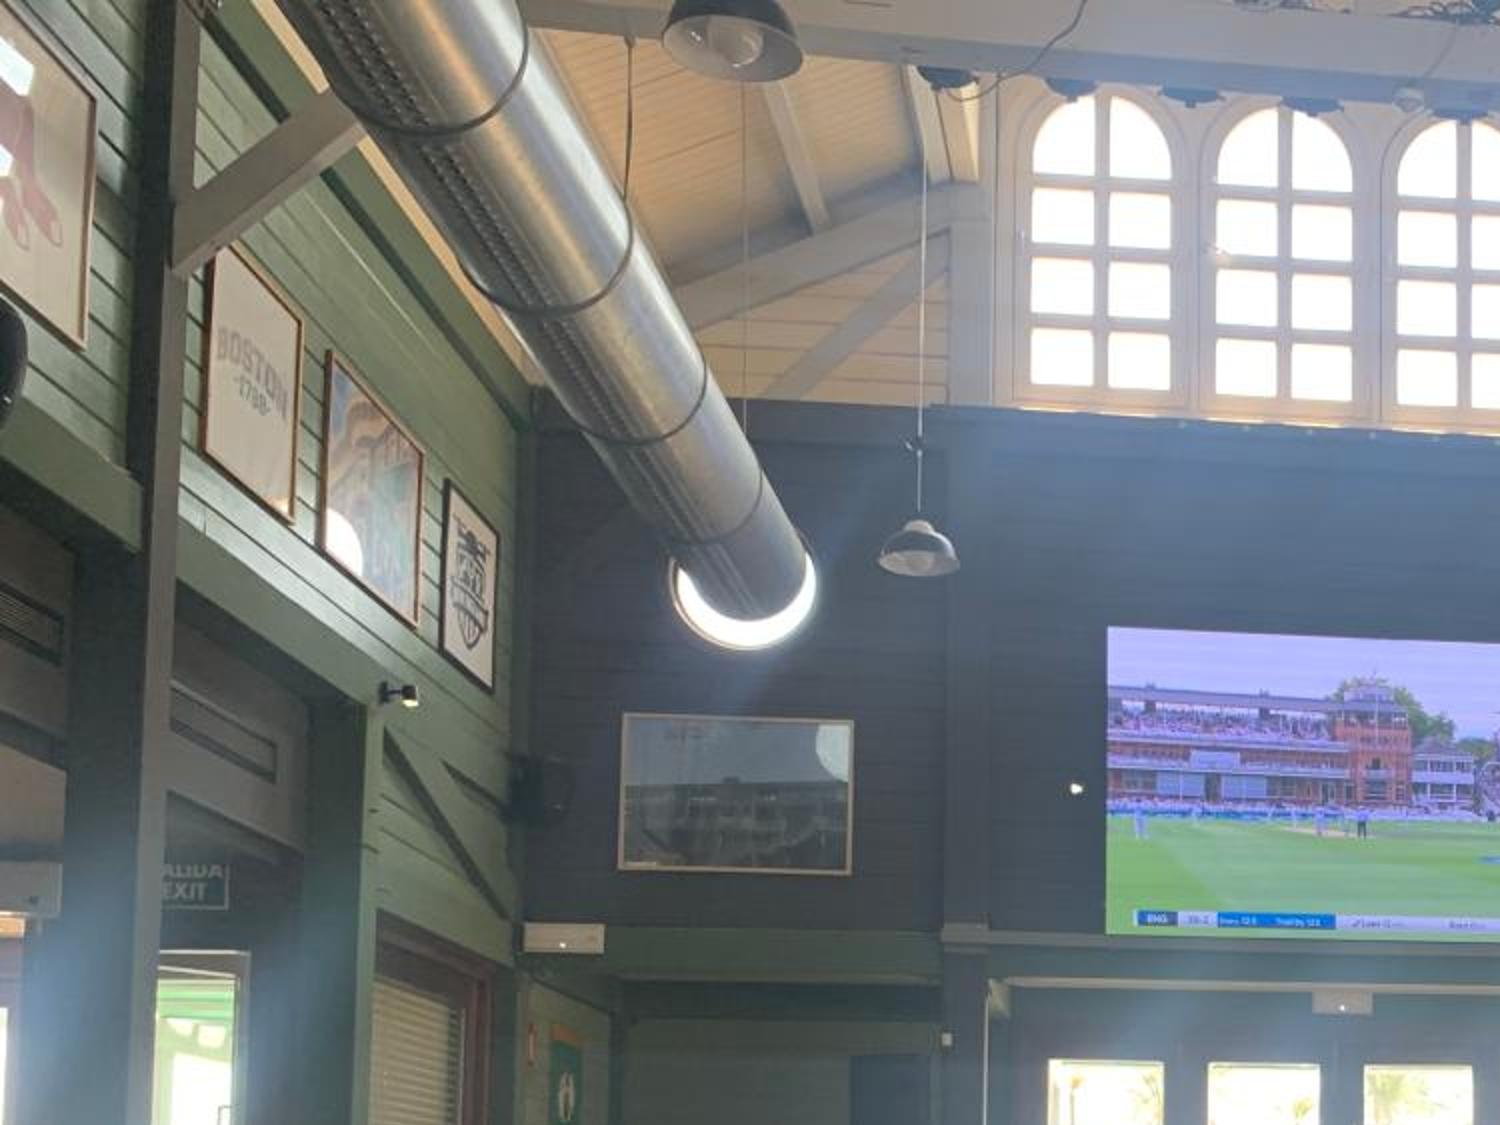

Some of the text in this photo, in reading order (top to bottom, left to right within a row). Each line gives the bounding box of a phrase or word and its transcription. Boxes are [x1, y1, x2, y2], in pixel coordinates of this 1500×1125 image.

[217, 329, 287, 420] BOSTON
[160, 862, 225, 879] ALIDA
[162, 882, 206, 900] EXIT
